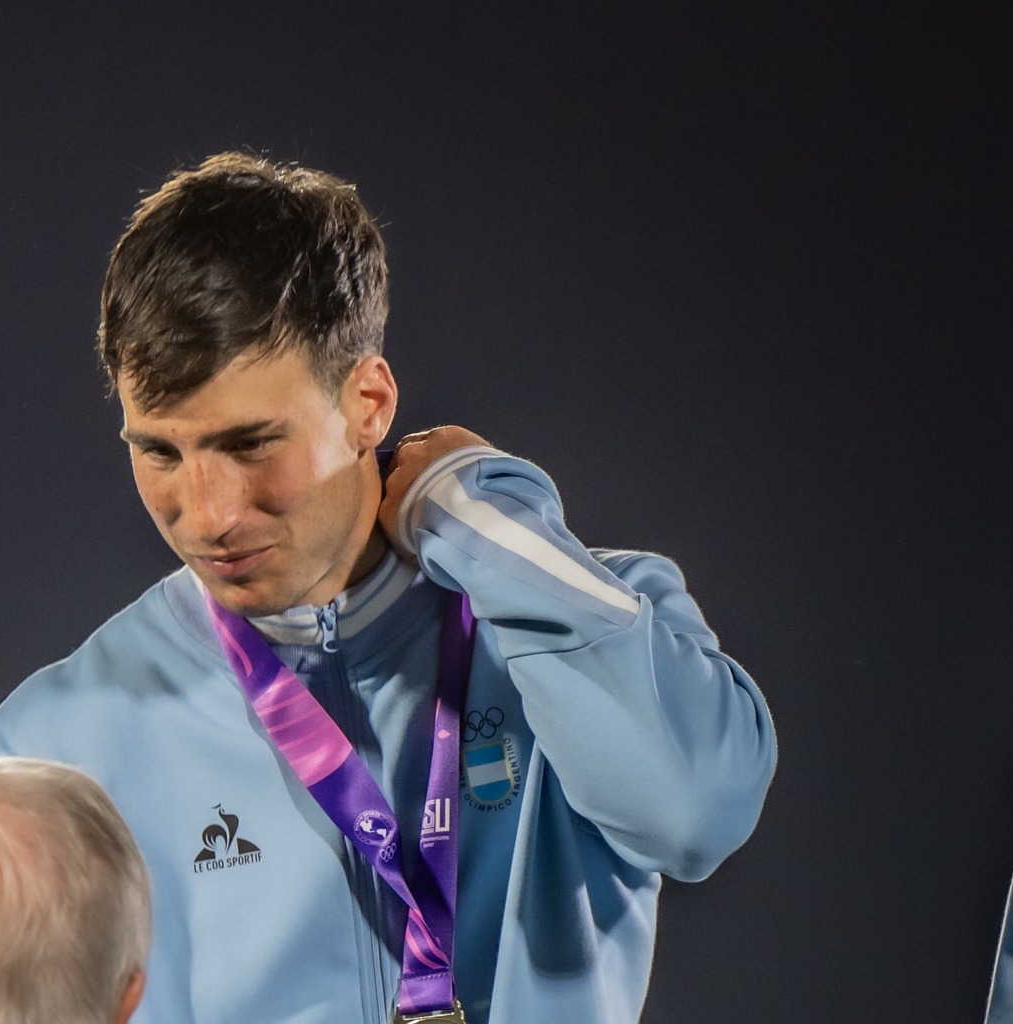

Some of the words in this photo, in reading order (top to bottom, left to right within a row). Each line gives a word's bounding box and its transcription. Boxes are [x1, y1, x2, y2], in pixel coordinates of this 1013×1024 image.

[464, 793, 512, 812] OLIMPICO
[504, 738, 521, 797] ARGENTINO
[194, 862, 204, 873] LE
[206, 859, 225, 871] COQ
[226, 852, 262, 868] SPORTIF
